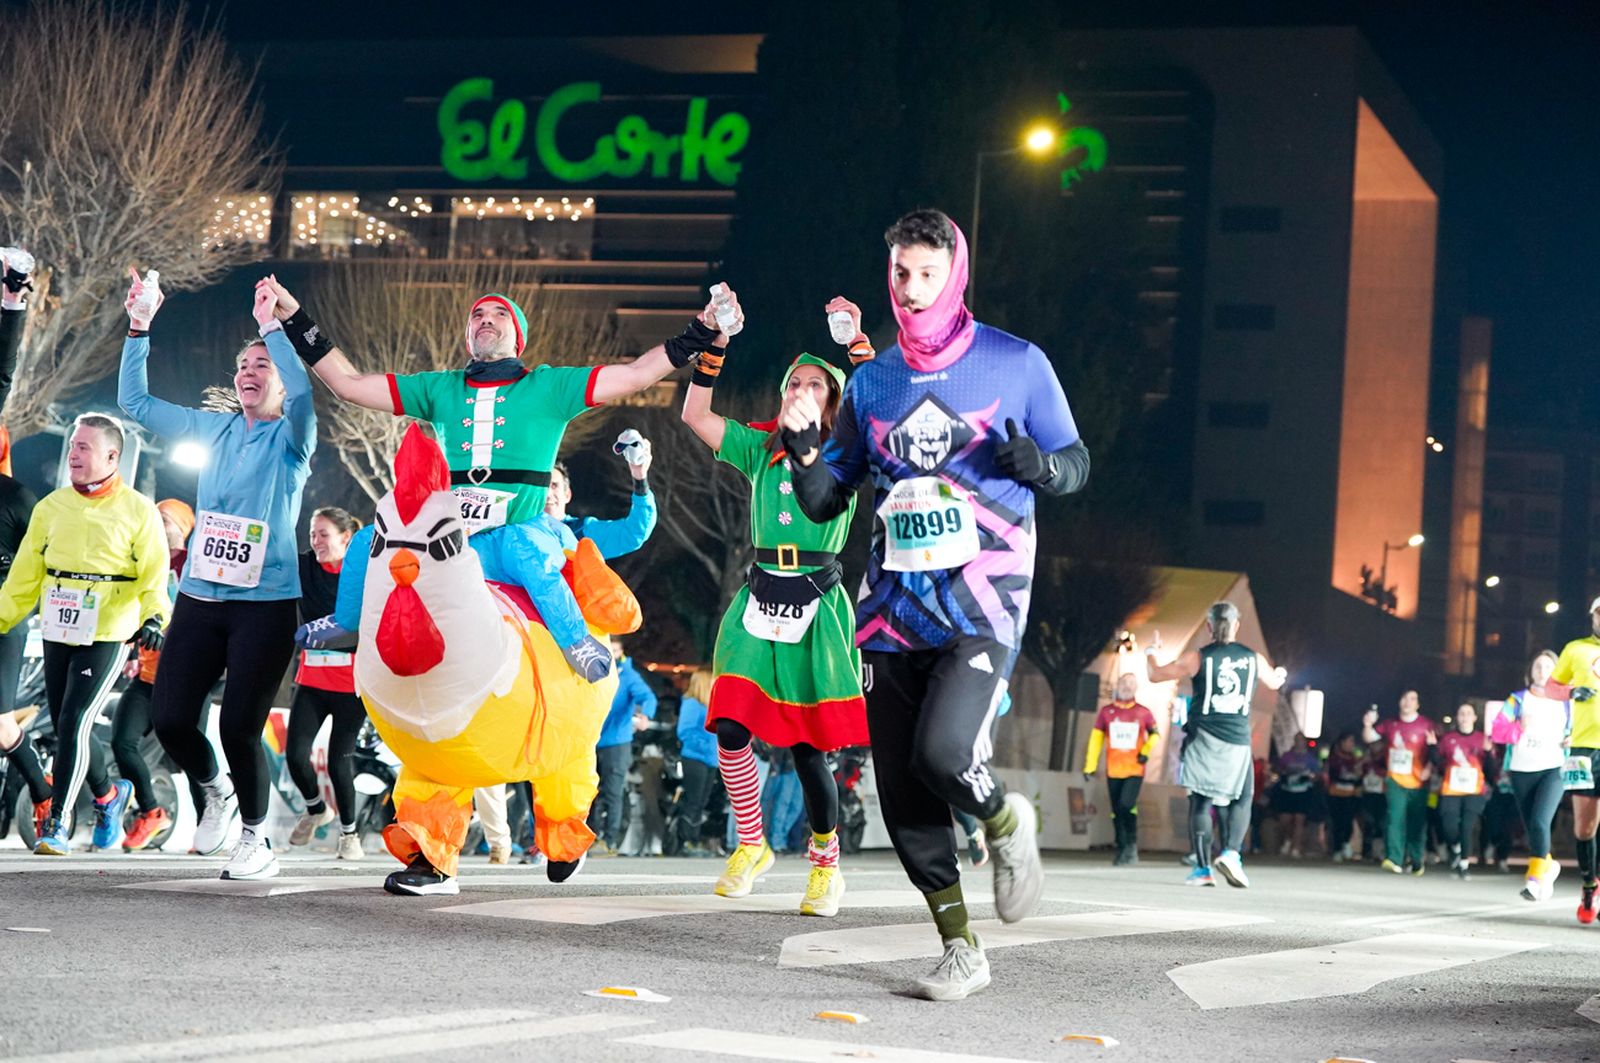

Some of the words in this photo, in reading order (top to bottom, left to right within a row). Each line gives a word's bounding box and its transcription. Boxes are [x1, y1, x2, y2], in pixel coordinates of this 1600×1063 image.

[438, 77, 528, 181] El
[535, 81, 749, 186] Corte
[893, 507, 962, 540] 12899
[203, 537, 251, 563] 6653
[58, 607, 80, 625] 197
